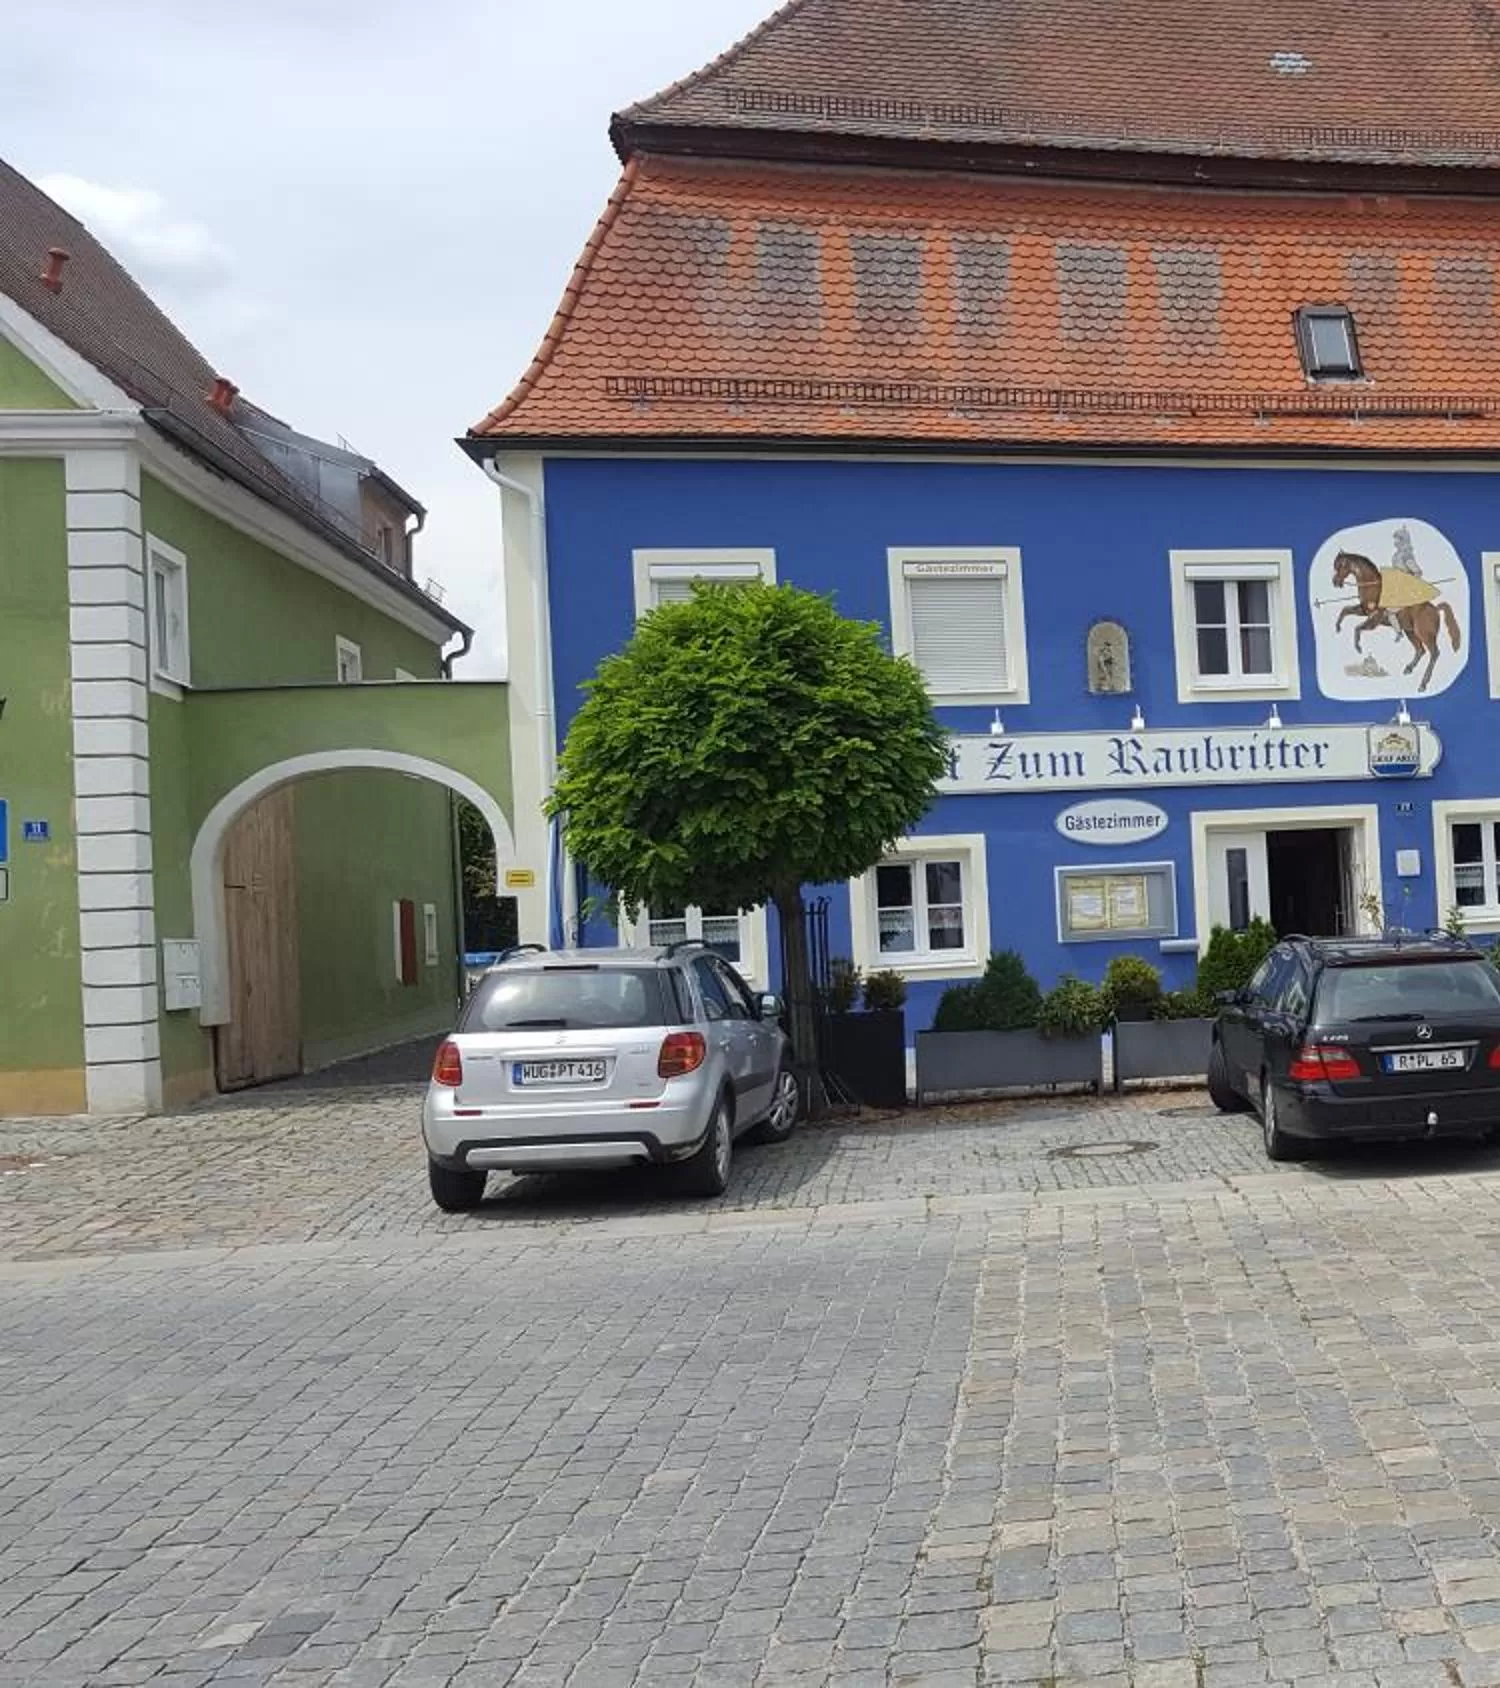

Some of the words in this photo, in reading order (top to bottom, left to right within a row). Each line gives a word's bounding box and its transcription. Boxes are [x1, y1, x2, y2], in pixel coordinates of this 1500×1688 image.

[985, 741, 1086, 781] Zum
[1107, 733, 1329, 776] Raubritter
[1065, 812, 1160, 831] Gästezimmer
